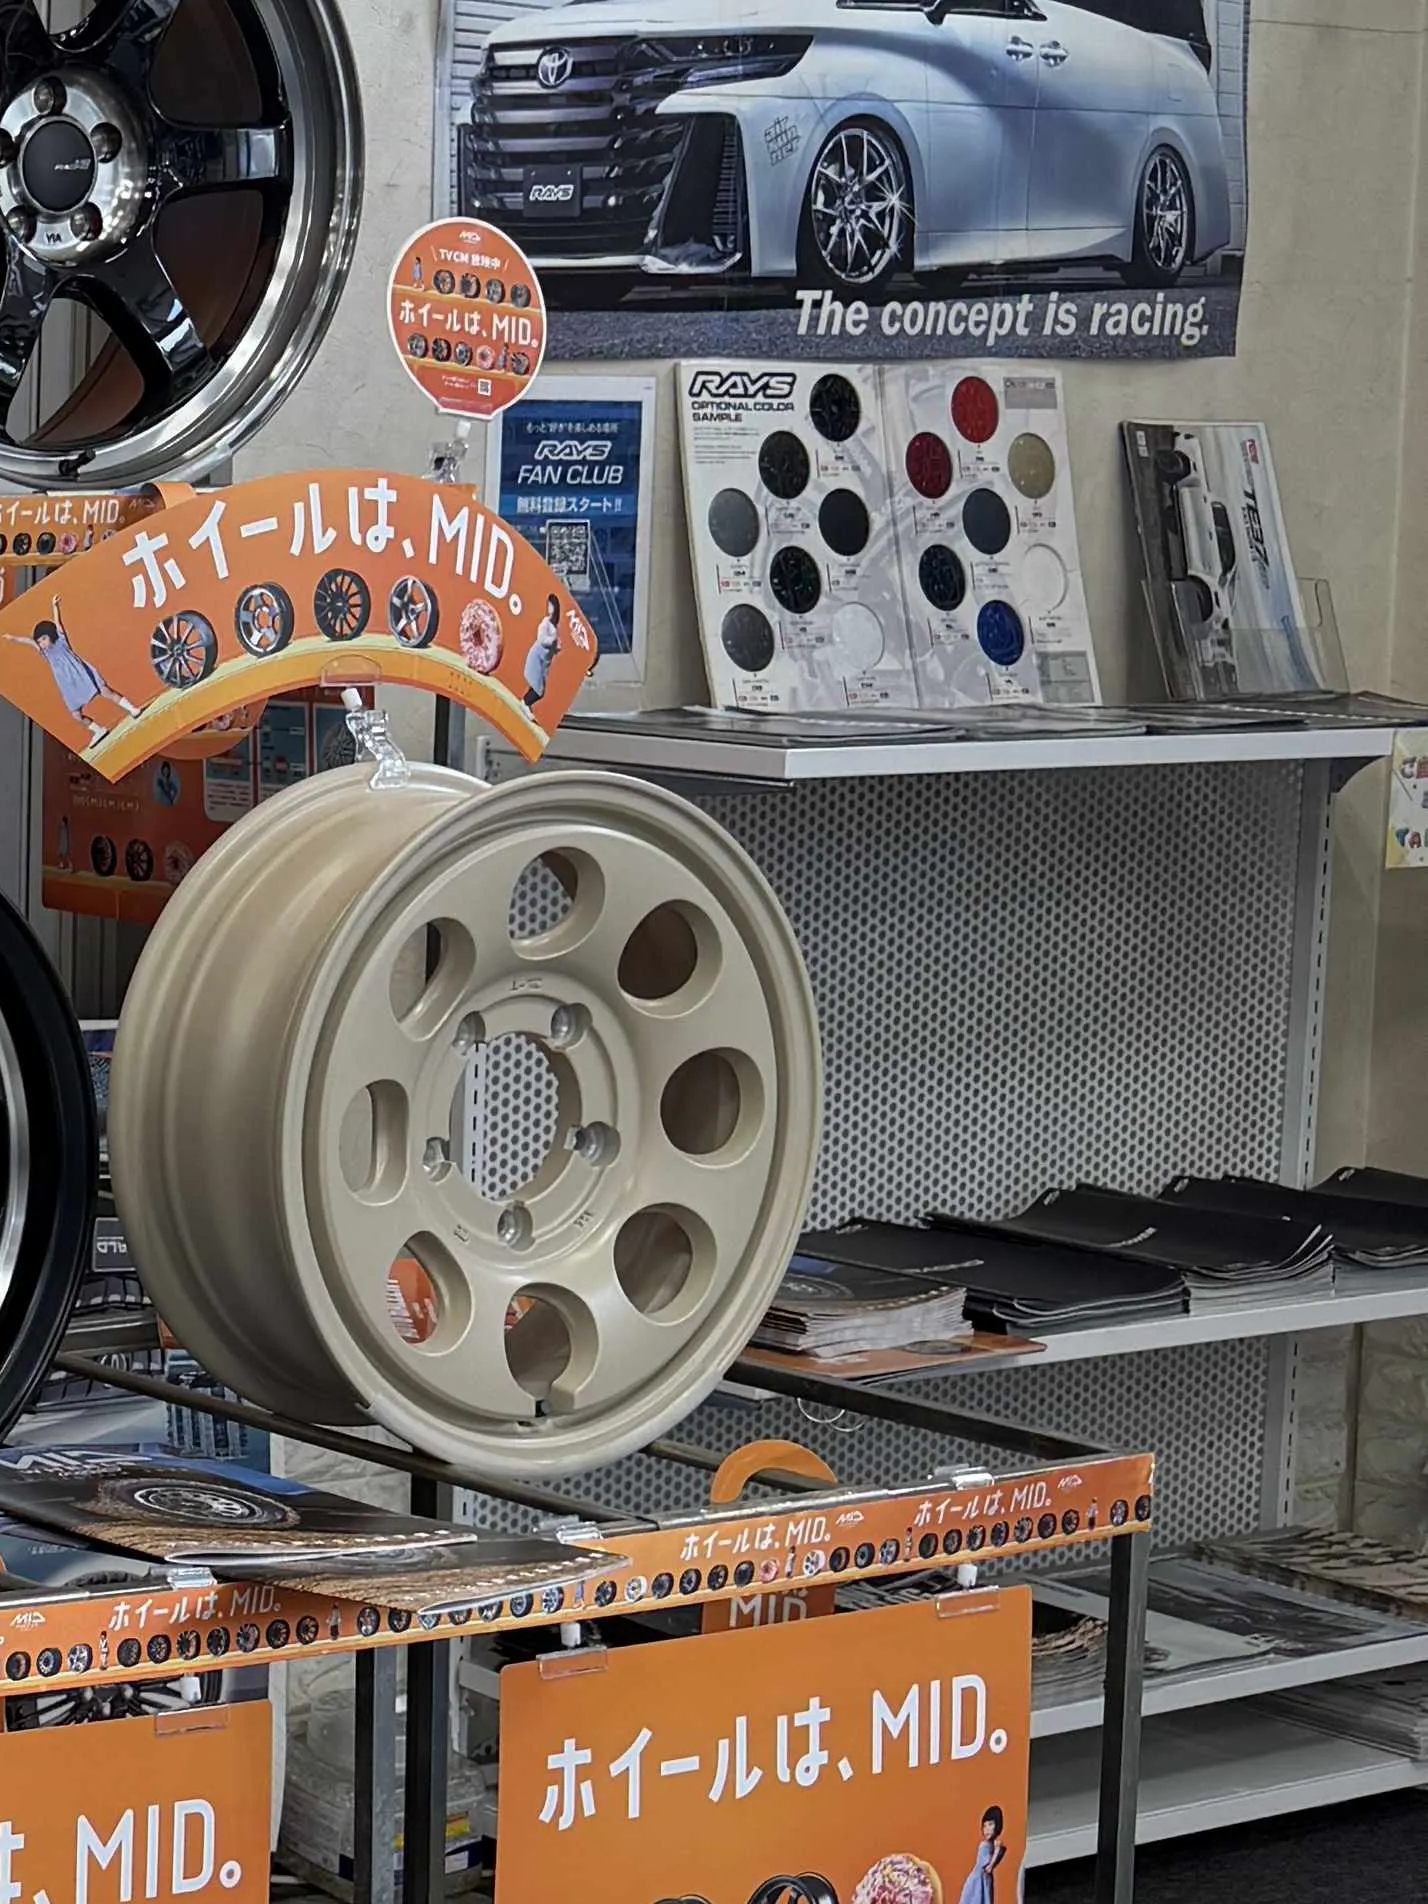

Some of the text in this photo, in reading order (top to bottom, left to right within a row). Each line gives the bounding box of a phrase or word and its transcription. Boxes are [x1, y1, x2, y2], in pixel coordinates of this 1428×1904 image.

[530, 185, 574, 201] RAYS
[399, 300, 540, 349] ホイールは、MID。
[795, 290, 1210, 347] The concept is racing.
[689, 371, 798, 398] RAYS
[691, 401, 796, 412] OPTIONAL COLOR
[692, 412, 744, 423] SAMPLE
[534, 440, 612, 460] RAYS
[517, 465, 625, 485] FAN CLUB
[122, 477, 522, 616] ホイールは、MID。
[913, 1485, 1054, 1527] ホイールは、MID。
[680, 1512, 832, 1562] ホイールは、MID。
[109, 1581, 282, 1632] ホイールは、MID。
[538, 1674, 1008, 1831] ホイールは、MID。
